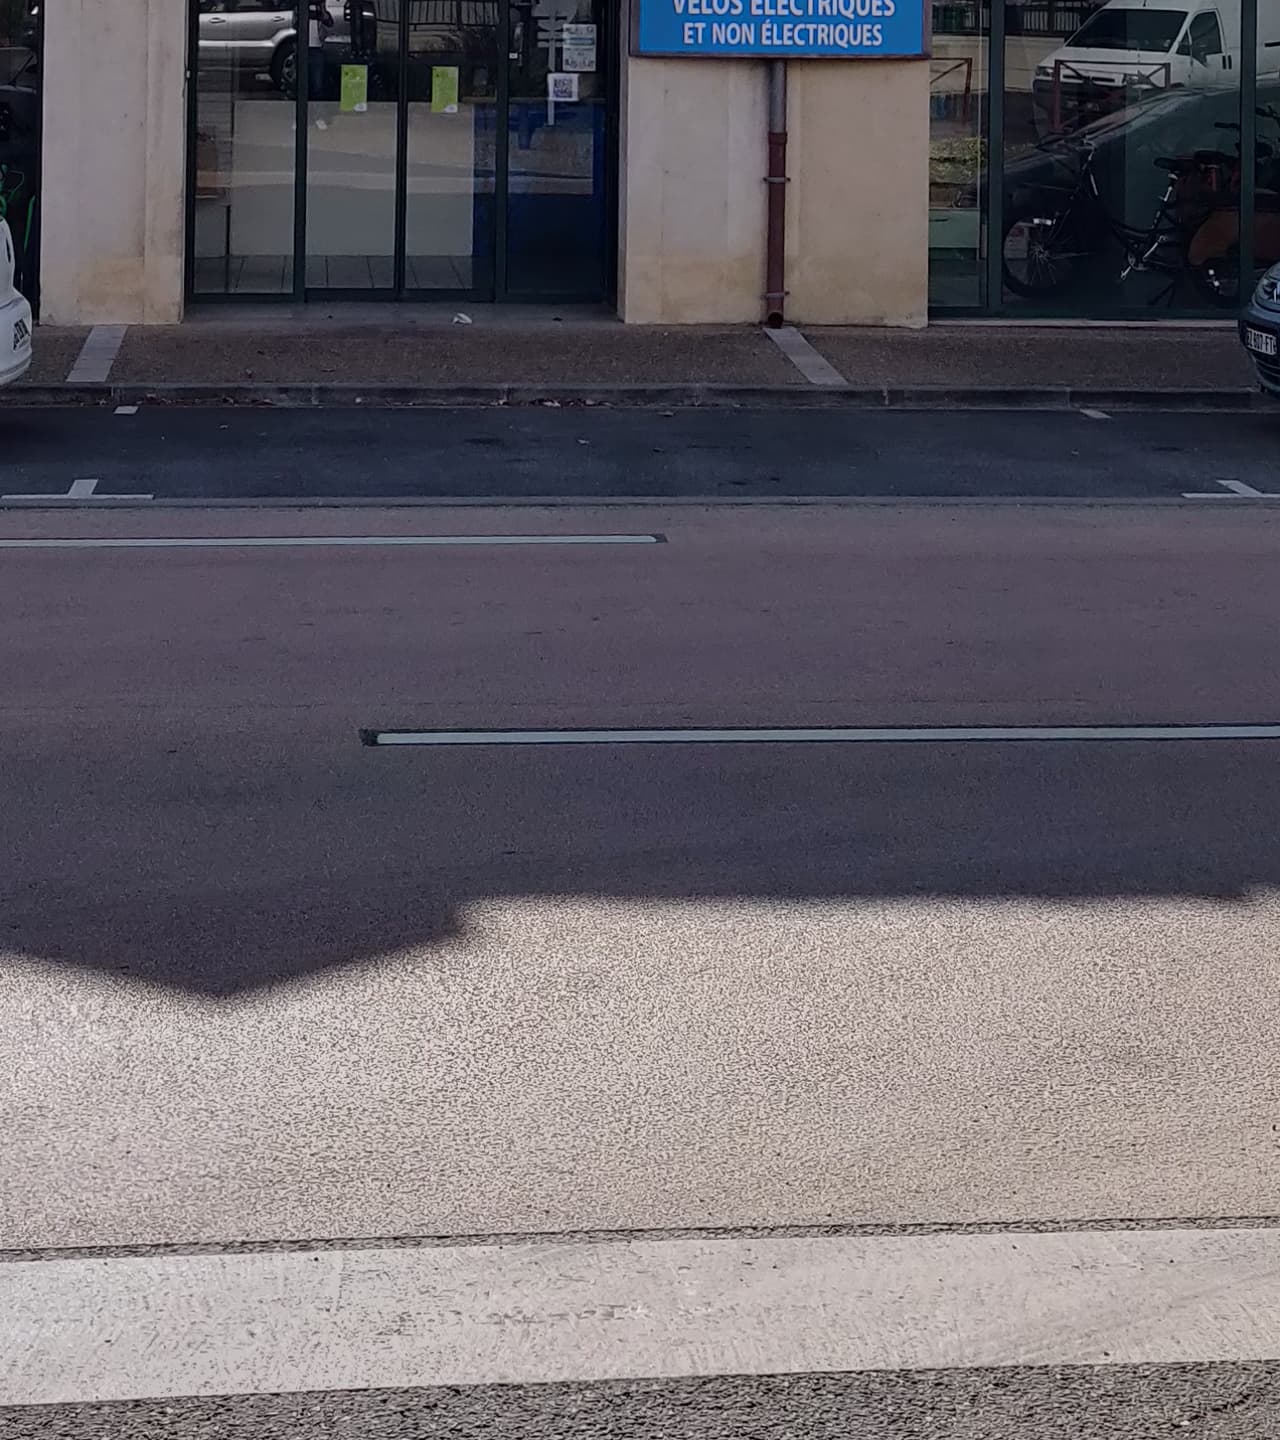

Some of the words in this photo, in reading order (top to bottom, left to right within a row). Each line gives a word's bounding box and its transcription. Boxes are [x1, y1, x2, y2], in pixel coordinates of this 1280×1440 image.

[684, 22, 706, 44] ET
[712, 23, 754, 44] NON
[761, 17, 882, 48] ÉLECTRIQUES
